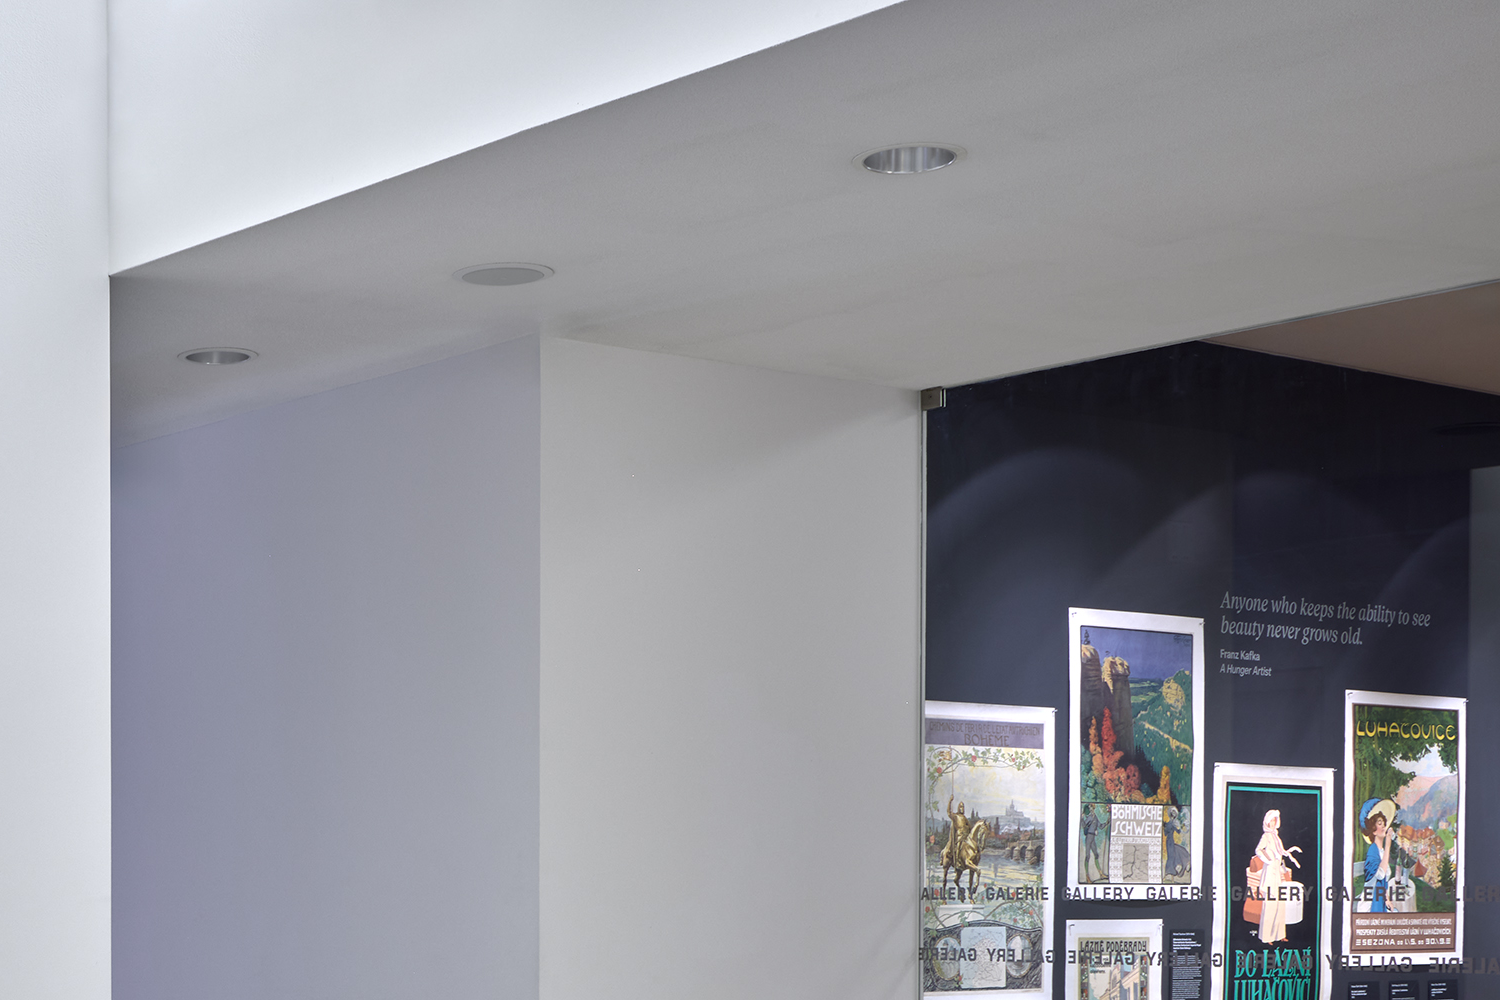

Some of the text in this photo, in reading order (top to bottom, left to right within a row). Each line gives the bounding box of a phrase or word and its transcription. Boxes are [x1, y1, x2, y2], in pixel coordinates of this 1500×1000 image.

[1220, 591, 1431, 627] Anyone who keeps the ability to see
[1220, 615, 1363, 645] beauty never grows old.
[1220, 649, 1260, 661] Franz Kafka
[1220, 664, 1272, 677] A Hunger Artist
[1356, 720, 1456, 740] LUHAČOVICE
[1111, 821, 1162, 836] SCHWEIZ
[985, 887, 1049, 900] GALERIE
[1062, 886, 1134, 900] GALLERY
[1146, 886, 1216, 901] GALERIE
[1232, 886, 1313, 901] GALLERY
[1325, 886, 1406, 902] GALERIE
[1362, 938, 1395, 946] SEZONA
[1234, 946, 1311, 978] DO LÁZNÍ
